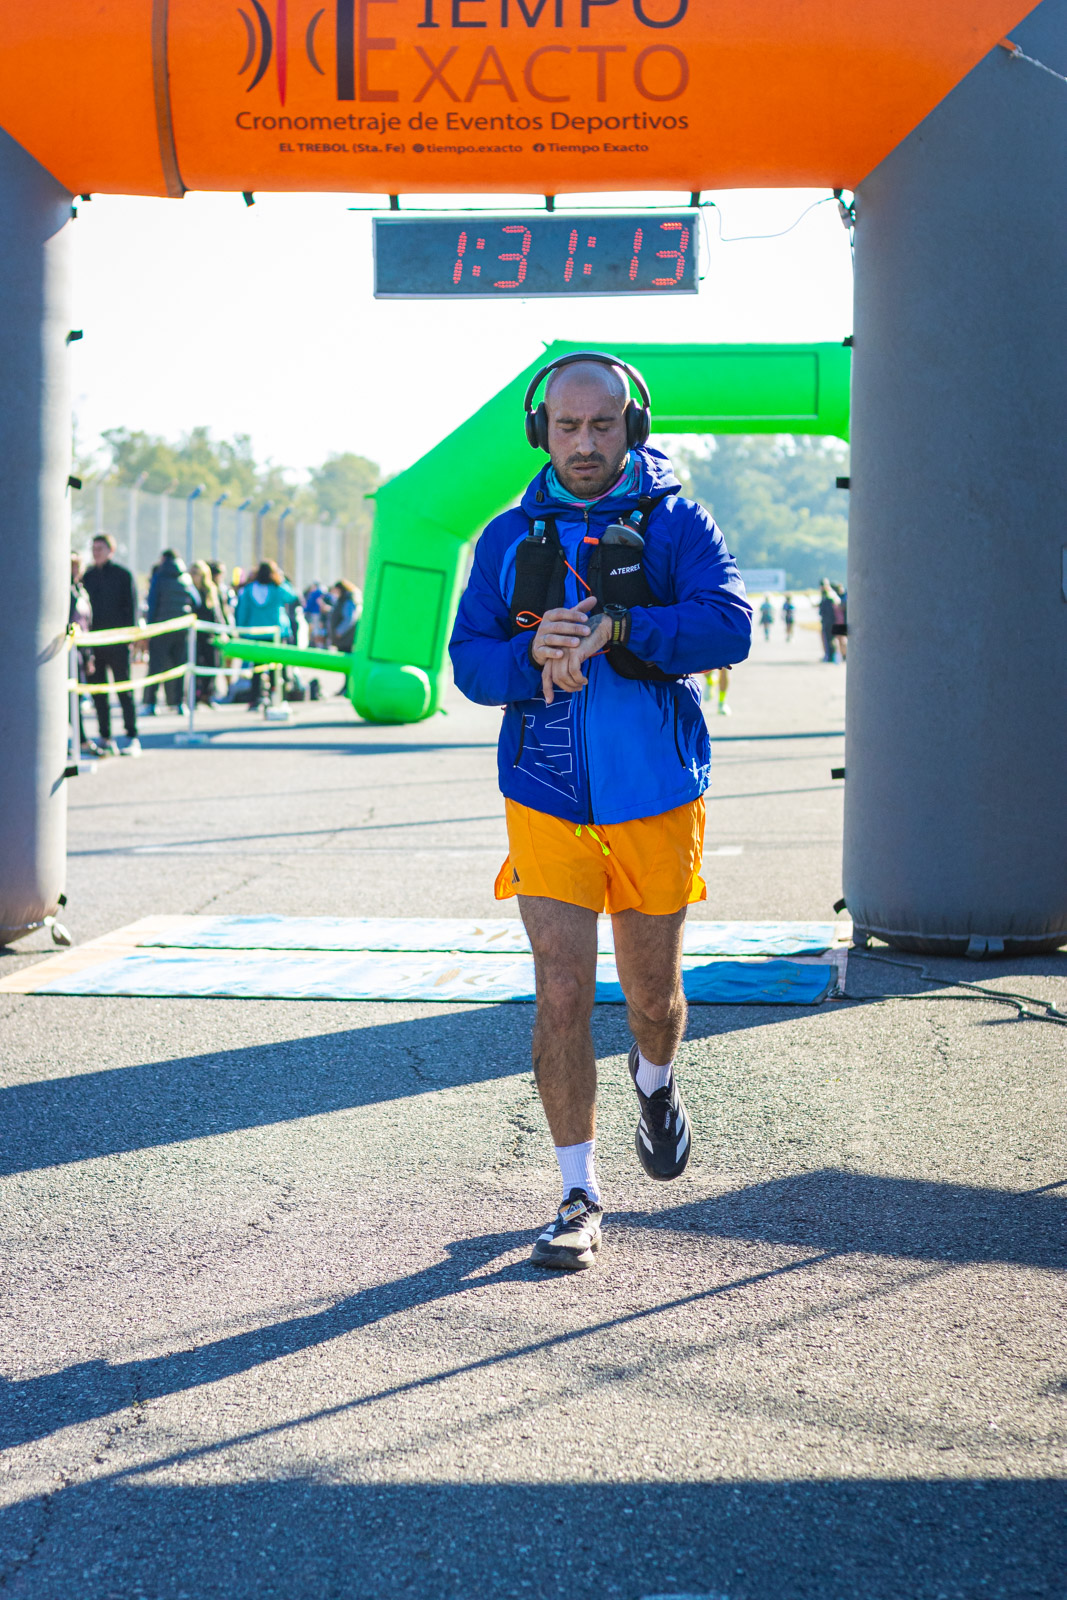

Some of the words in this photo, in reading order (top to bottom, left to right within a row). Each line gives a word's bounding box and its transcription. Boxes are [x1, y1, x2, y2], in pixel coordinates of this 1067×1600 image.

[235, 111, 401, 135] Cronometraje
[408, 111, 439, 131] de
[446, 112, 543, 131] Eventos
[551, 111, 689, 134] Deportivos
[279, 143, 295, 153] EL
[297, 143, 350, 153] TREBOL
[352, 143, 383, 154] (Sta.
[385, 143, 406, 154] Fe)
[547, 143, 600, 154] Tiempo
[603, 143, 649, 153] Exacto
